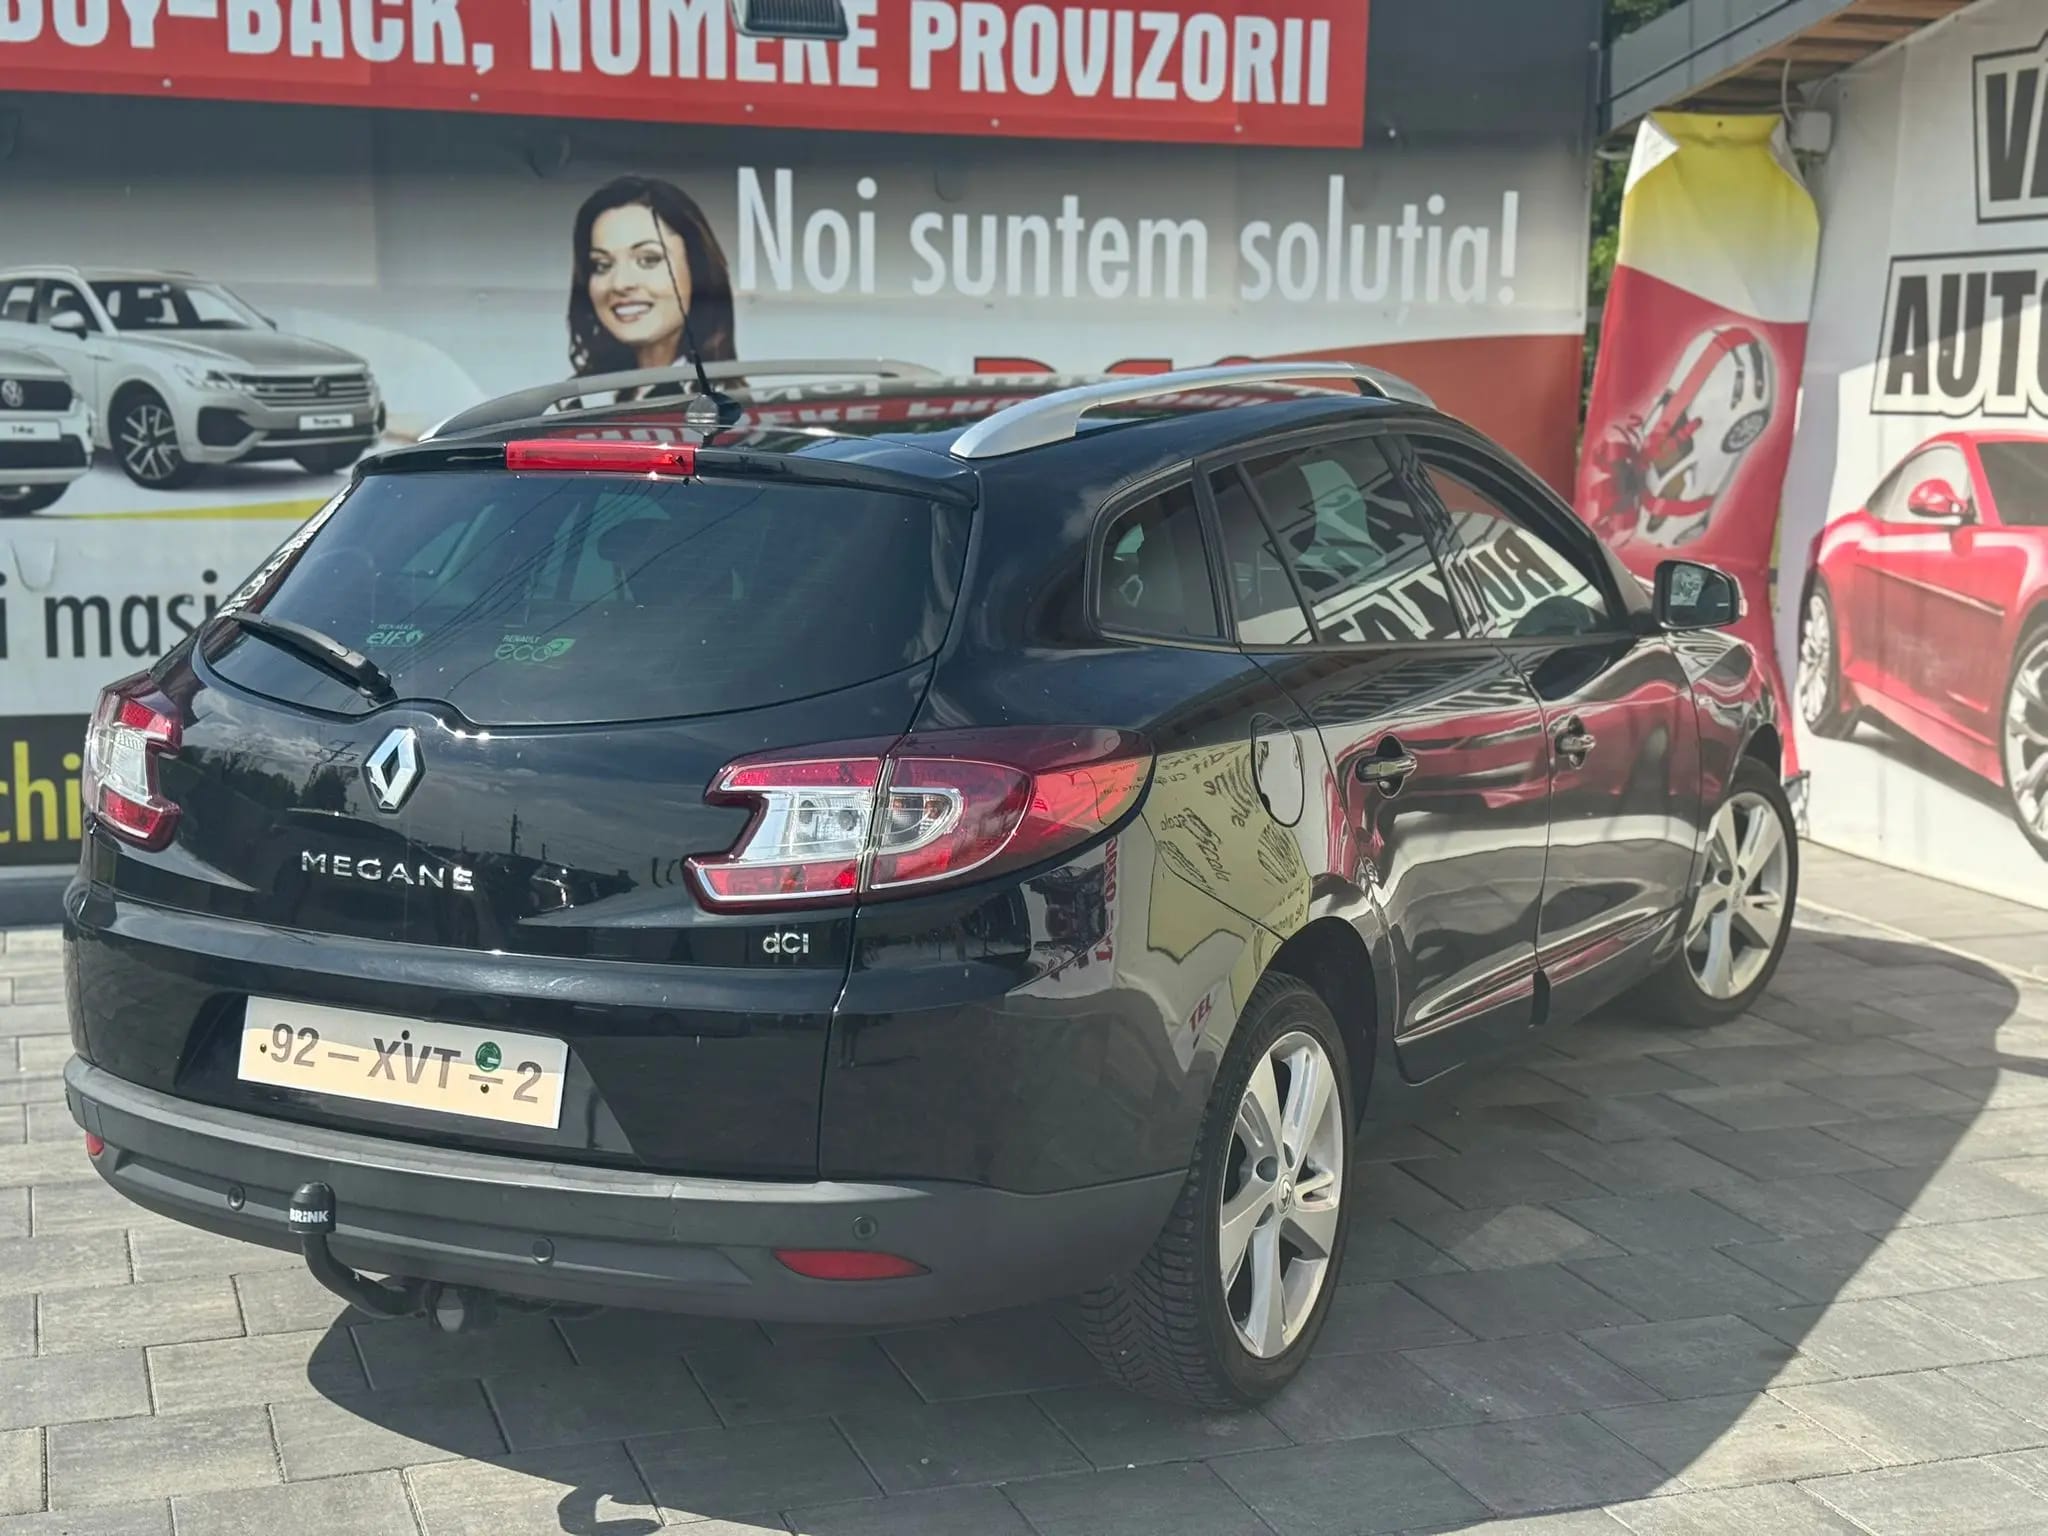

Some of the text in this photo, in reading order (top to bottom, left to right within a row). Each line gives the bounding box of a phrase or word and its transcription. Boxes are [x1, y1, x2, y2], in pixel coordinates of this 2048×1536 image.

[910, 0, 1330, 106] PROVIZORII
[1985, 67, 2048, 203] V
[737, 166, 878, 295] Noi
[909, 195, 1208, 300] suntem
[1884, 270, 2048, 400] AUT
[44, 569, 233, 660] masi
[301, 849, 475, 892] MEGANE
